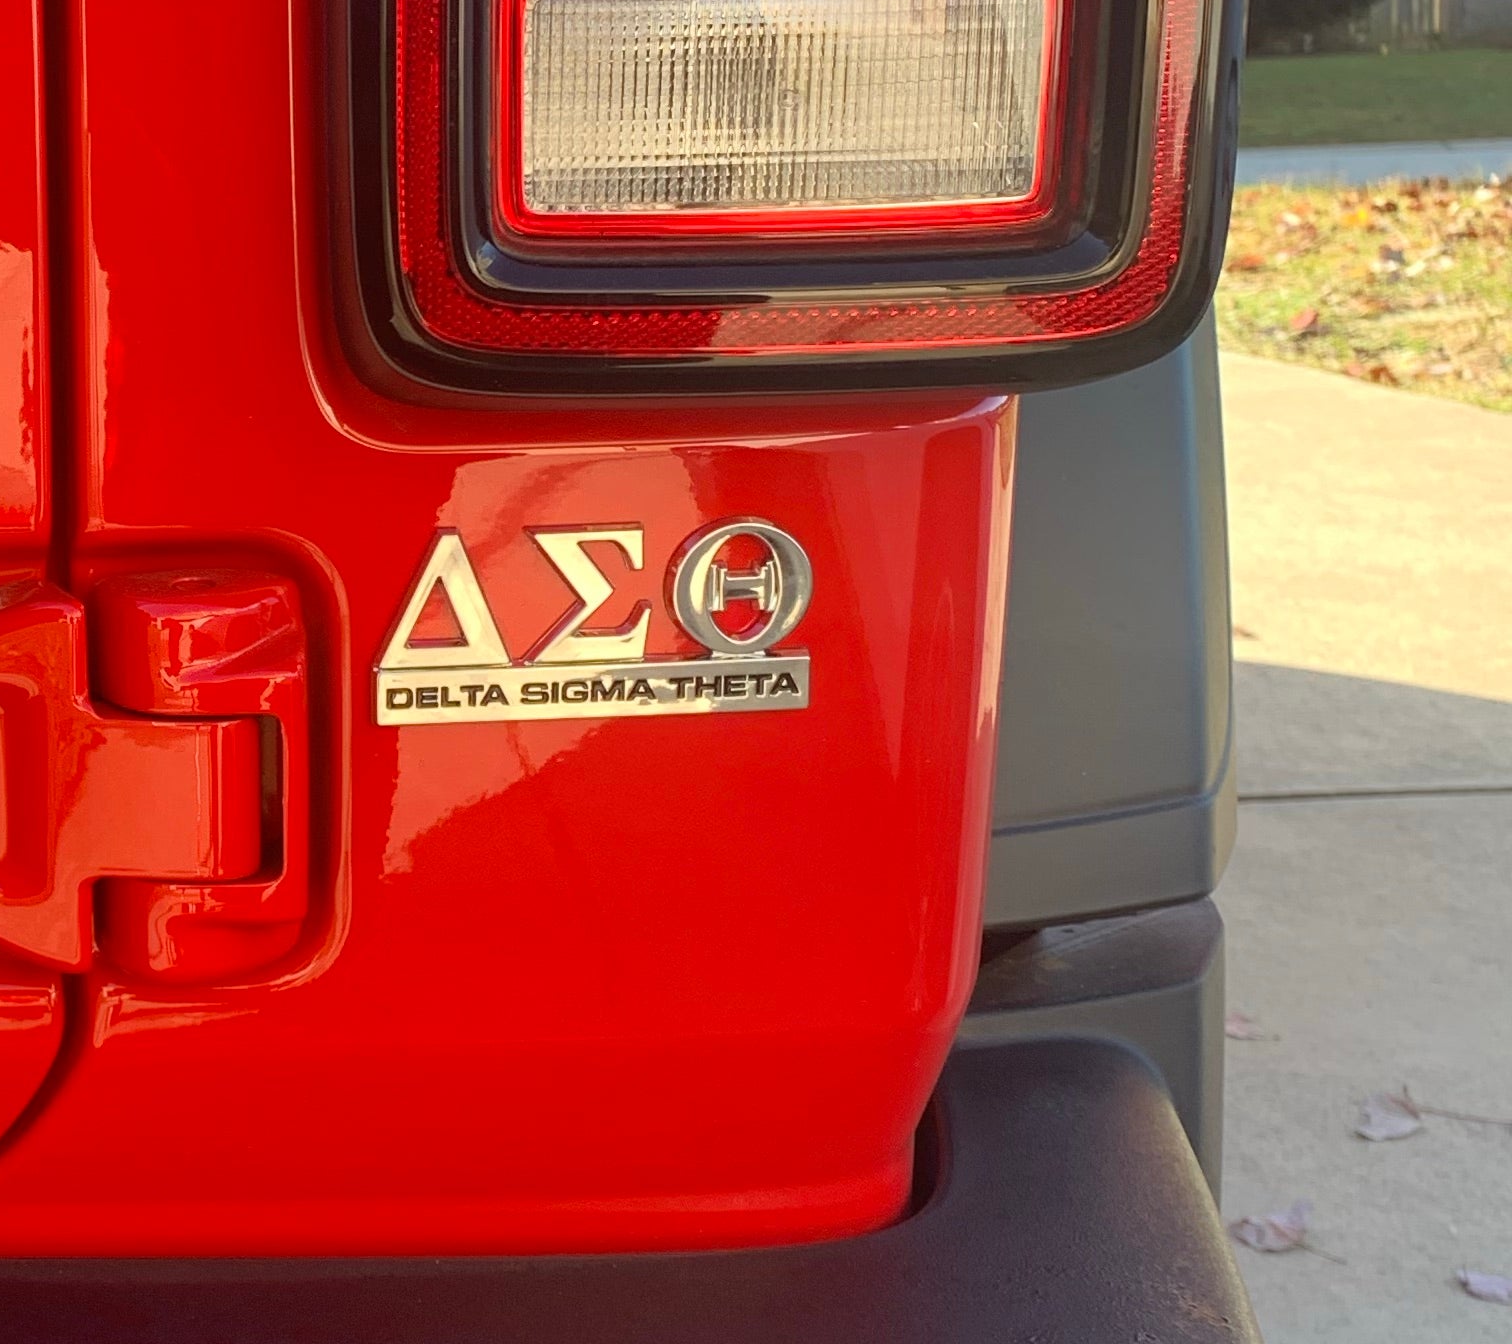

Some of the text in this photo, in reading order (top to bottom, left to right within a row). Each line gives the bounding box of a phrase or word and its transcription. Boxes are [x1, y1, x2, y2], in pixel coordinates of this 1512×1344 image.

[385, 672, 801, 710] DELTA SIGMA THETA
